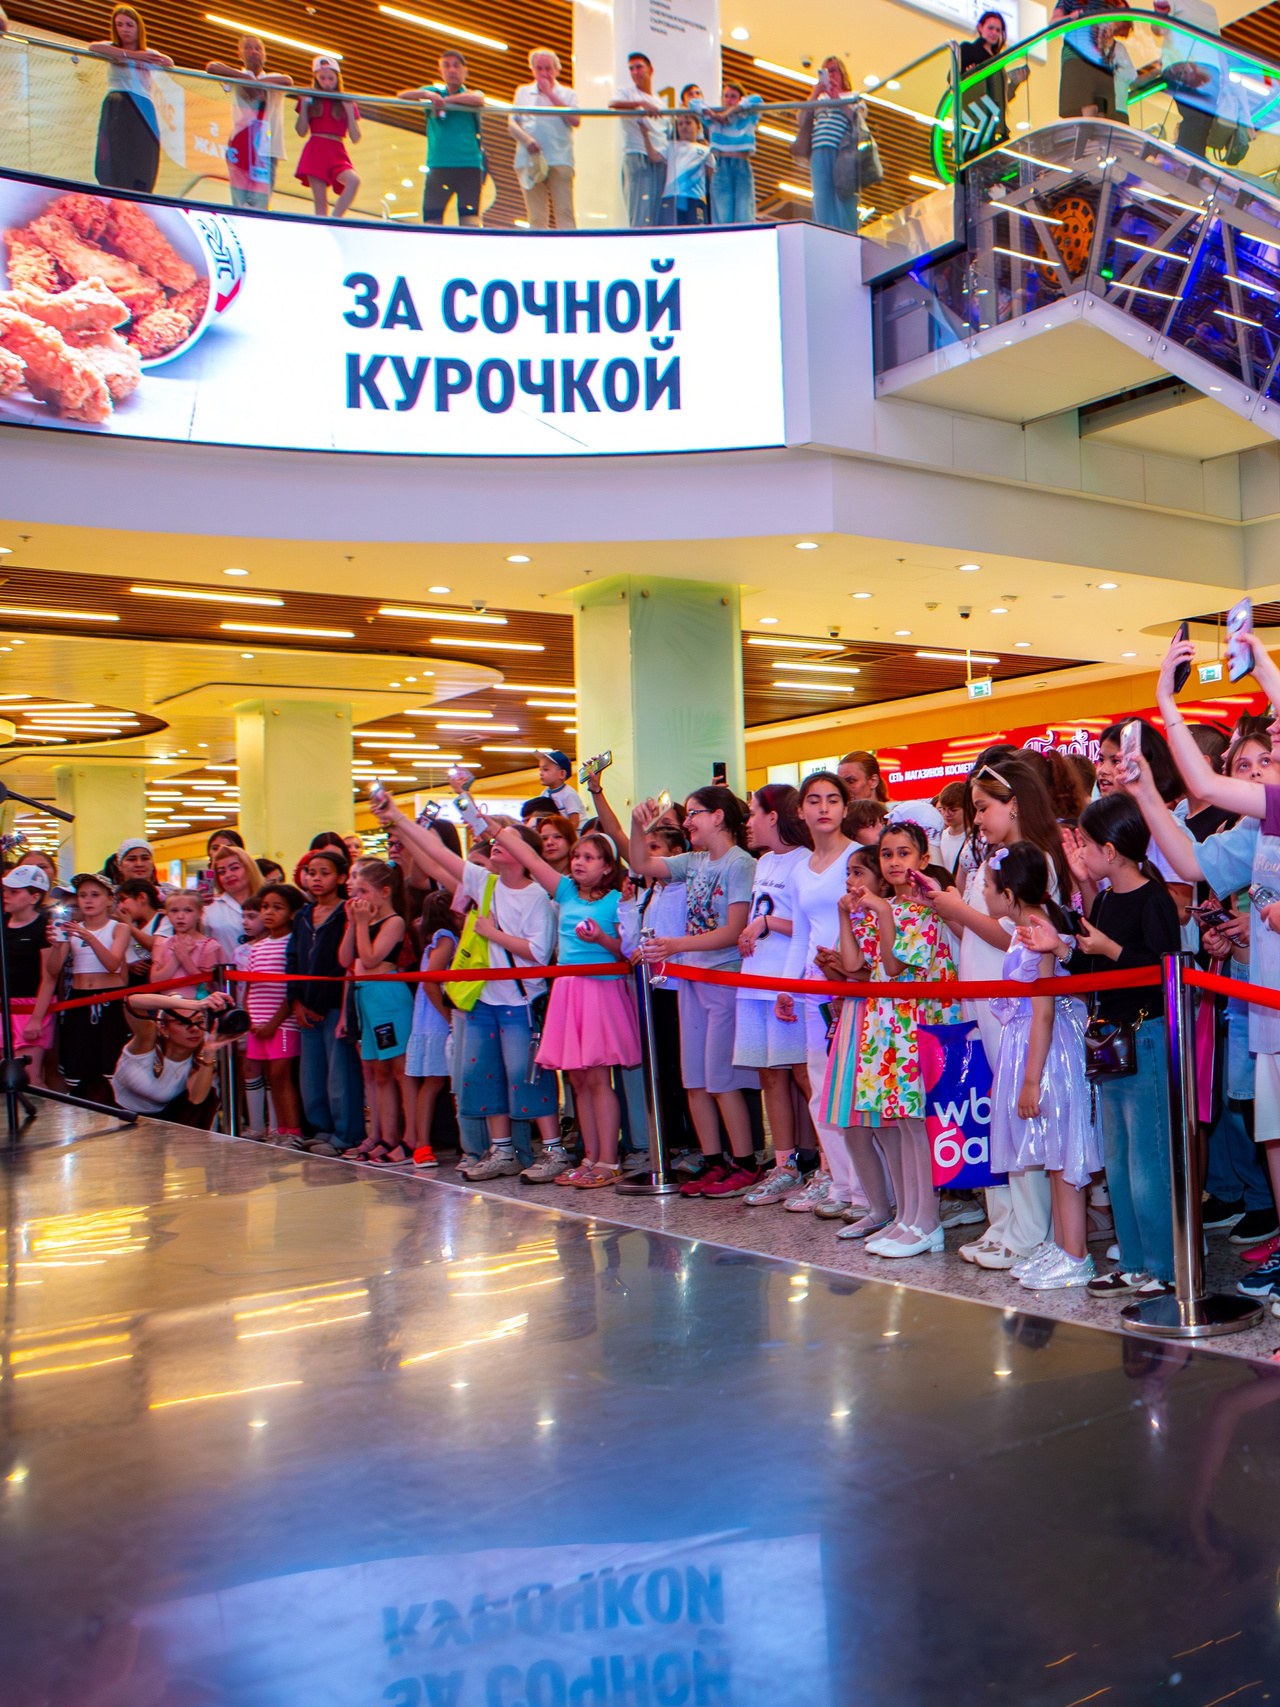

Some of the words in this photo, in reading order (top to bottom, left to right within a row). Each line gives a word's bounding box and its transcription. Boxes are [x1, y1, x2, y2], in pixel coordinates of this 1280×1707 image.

[343, 271, 423, 331] ЗА
[442, 258, 682, 334] СОЧНОЙ
[345, 335, 682, 413] КУРОЧКОЙ
[888, 772, 904, 783] СЕТЬ
[904, 766, 944, 781] МАГАЗИНОВ
[933, 1086, 991, 1128] wb
